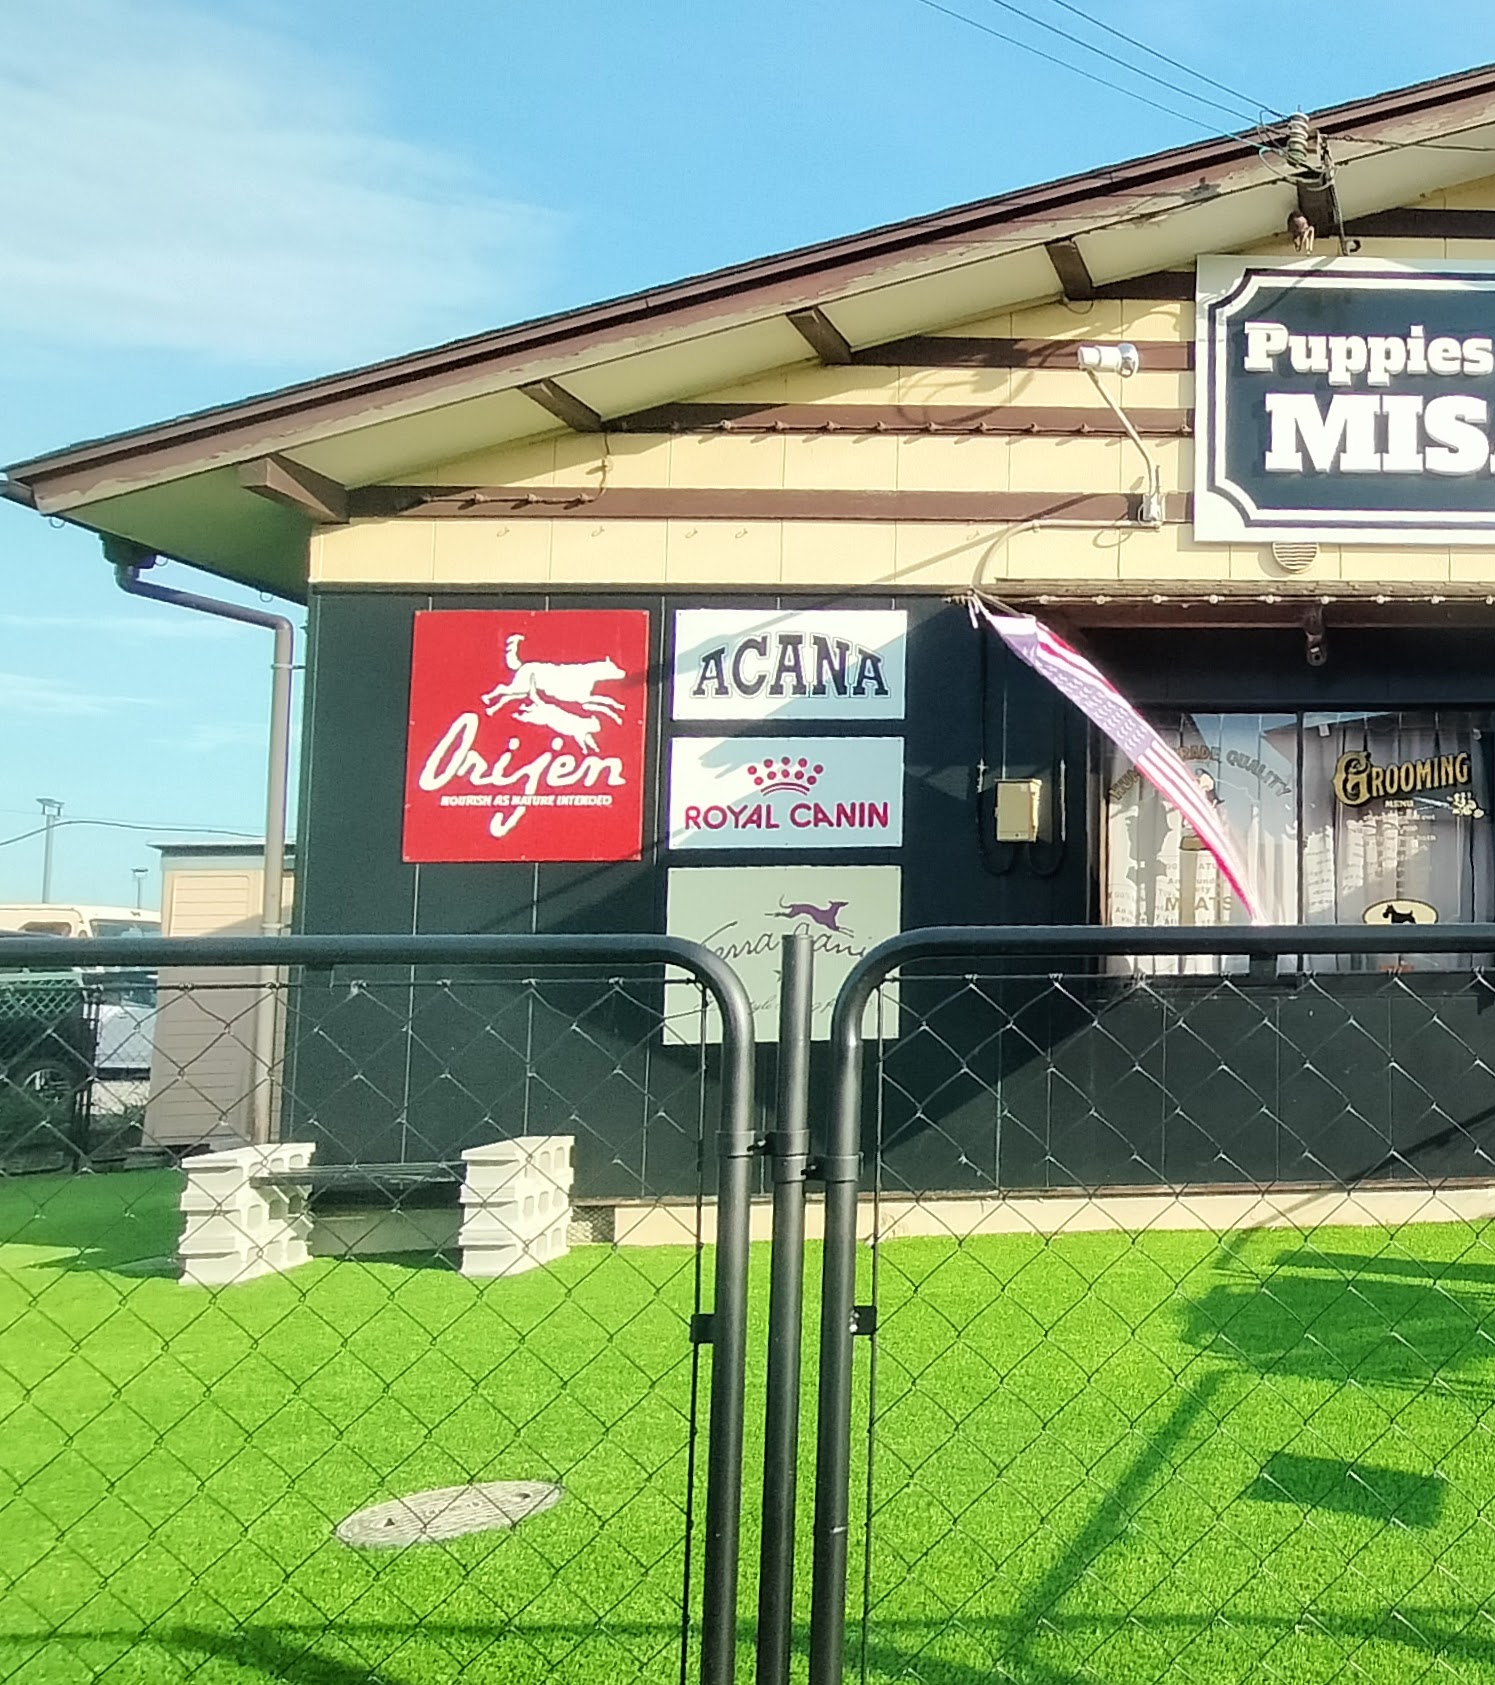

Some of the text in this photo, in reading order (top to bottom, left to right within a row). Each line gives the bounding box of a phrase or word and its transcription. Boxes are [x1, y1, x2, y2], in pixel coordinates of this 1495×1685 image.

[1243, 321, 1495, 386] Puppies
[689, 633, 891, 699] ACANA
[419, 712, 626, 837] Orijen
[1174, 744, 1222, 764] RADE
[1226, 750, 1293, 797] QUALITY
[1332, 751, 1470, 806] GROOMING
[440, 795, 613, 806] NOURISH AS NATURE INTENDED
[685, 802, 889, 829] ROYAL CANIN
[1165, 896, 1232, 912] MATS
